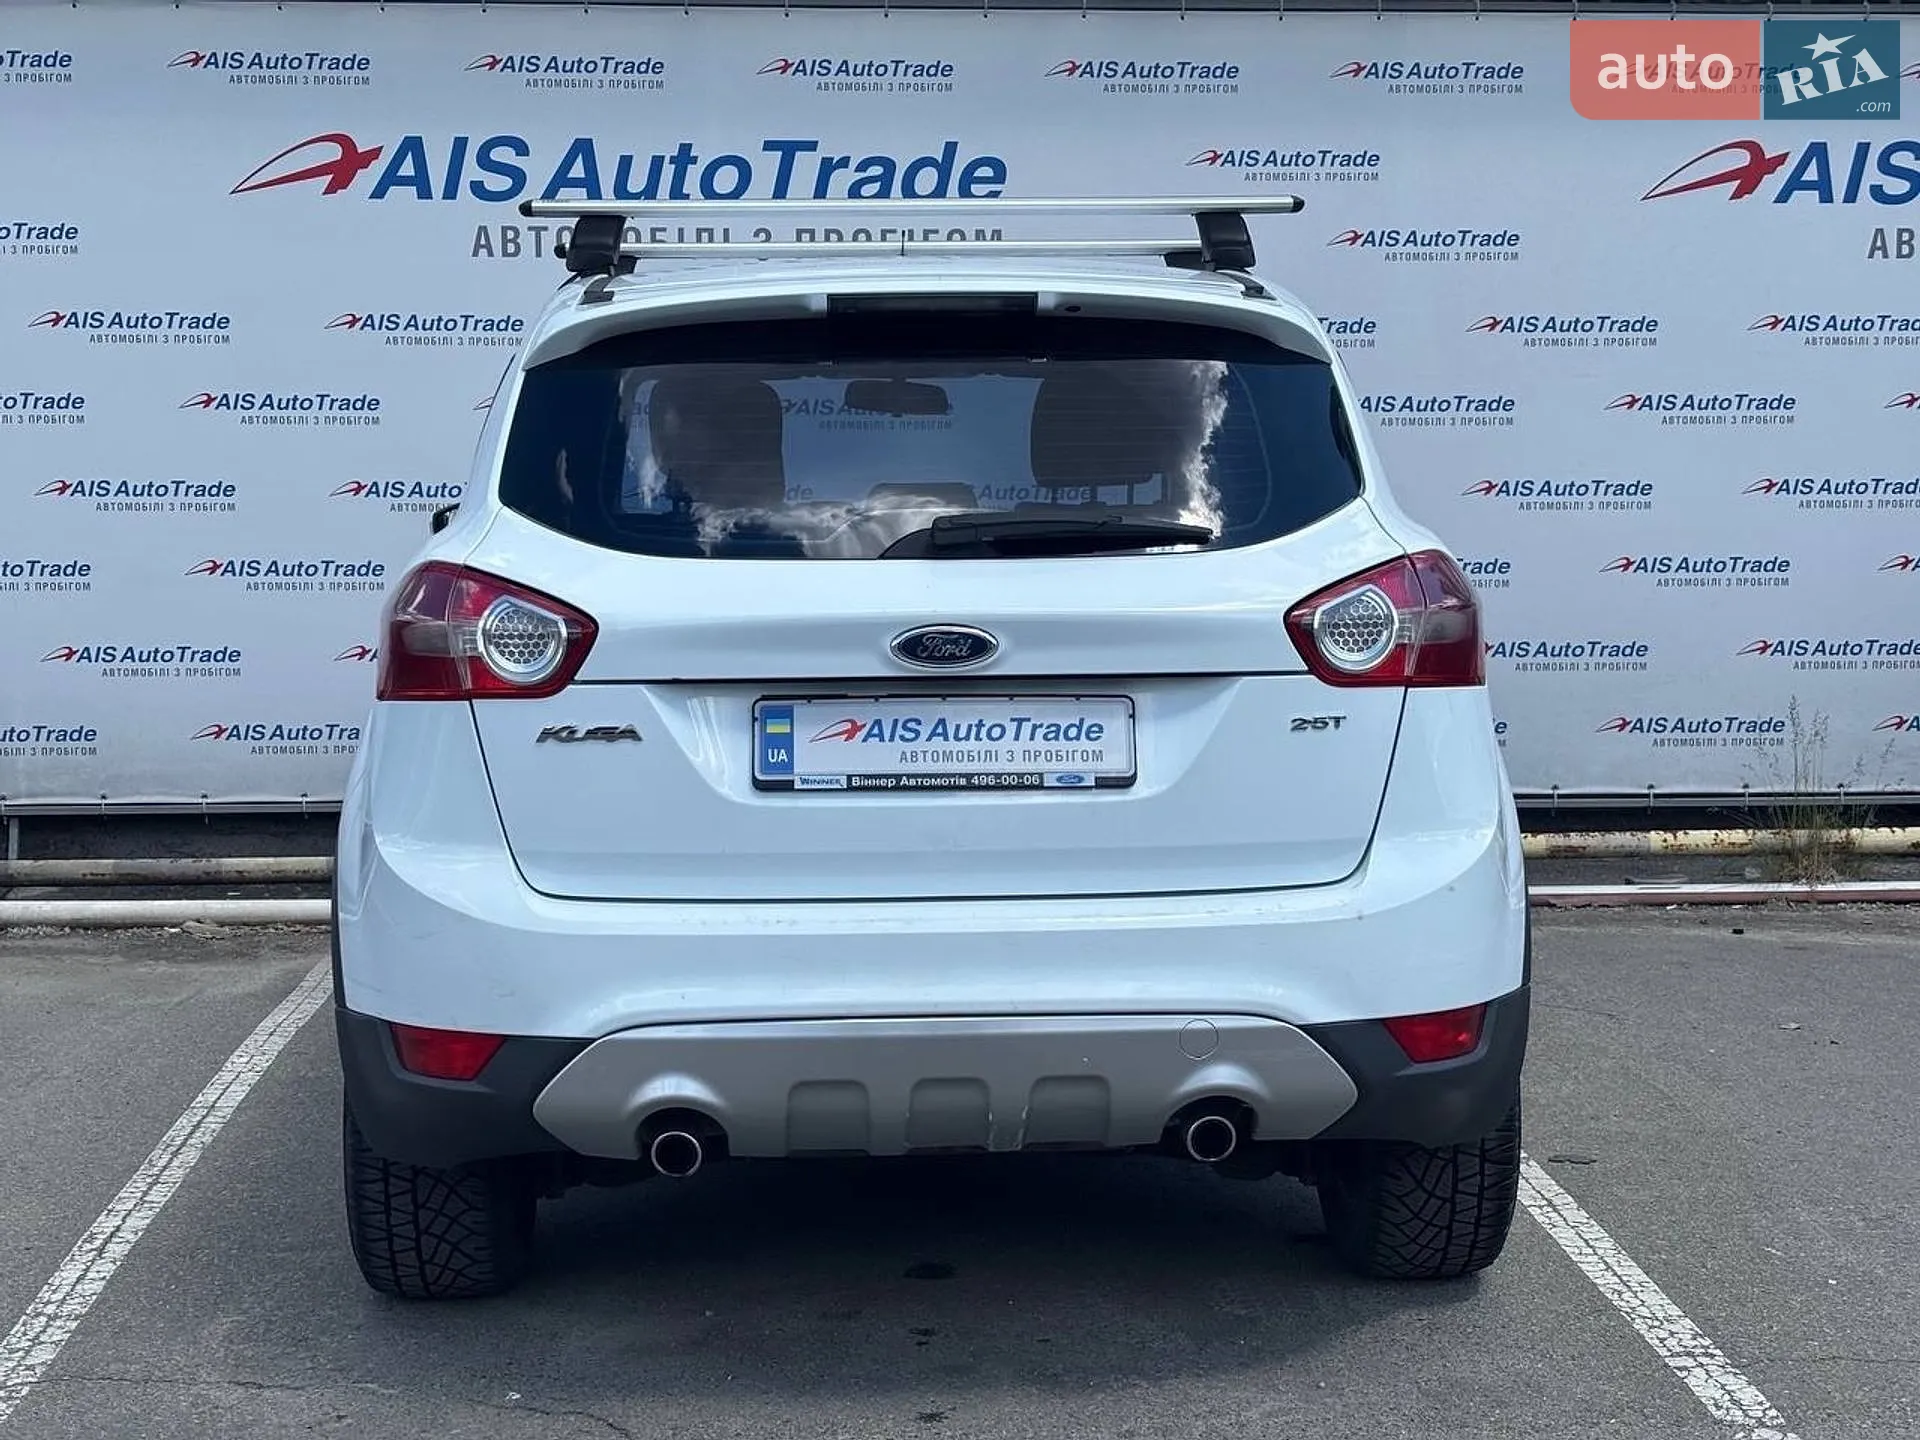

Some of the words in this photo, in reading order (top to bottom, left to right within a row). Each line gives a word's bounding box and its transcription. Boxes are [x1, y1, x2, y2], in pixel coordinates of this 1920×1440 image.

[203, 52, 244, 69] AIS
[248, 53, 370, 70] AutoTrade
[500, 56, 541, 73] AIS
[544, 56, 664, 74] AutoTrade
[792, 59, 832, 76] AIS
[835, 60, 954, 77] AutoTrade
[1079, 61, 1119, 78] AIS
[1121, 61, 1240, 79] AutoTrade
[1364, 62, 1404, 79] AIS
[1406, 62, 1524, 79] AutoTrade
[1220, 150, 1260, 167] AIS
[1262, 150, 1380, 167] AutoTrade
[370, 136, 530, 201] AIS
[540, 137, 1007, 200] AutoTrade
[1360, 231, 1401, 247] AIS
[1403, 230, 1520, 247] AutoTrade
[63, 312, 105, 328] AIS
[108, 312, 230, 329] AutoTrade
[360, 314, 400, 331] AIS
[403, 314, 524, 332] AutoTrade
[1499, 317, 1540, 333] AIS
[1541, 316, 1659, 333] AutoTrade
[1781, 315, 1821, 331] AIS
[0, 392, 85, 410] oTrade
[215, 394, 256, 410] AIS
[259, 394, 380, 411] AutoTrade
[1398, 395, 1515, 412] AutoTrade
[1638, 395, 1678, 411] AIS
[1680, 394, 1796, 411] AutoTrade
[70, 480, 111, 497] AIS
[114, 480, 236, 498] AutoTrade
[365, 482, 405, 498] AIS
[1495, 481, 1535, 496] AIS
[1537, 480, 1653, 496] AutoTrade
[1775, 479, 1815, 495] AIS
[1816, 478, 1920, 495] AutoTrad
[1, 560, 91, 577] toTrade
[220, 560, 261, 576] AIS
[264, 560, 385, 577] AutoTrade
[1633, 557, 1673, 573] AIS
[1674, 556, 1791, 573] AutoTrade
[76, 647, 117, 663] AIS
[120, 646, 241, 663] AutoTrade
[1491, 642, 1531, 658] AIS
[1533, 641, 1648, 658] AutoTrade
[1770, 640, 1810, 656] AIS
[225, 725, 266, 741] AIS
[269, 724, 360, 741] AutoTra
[862, 718, 923, 743] AIS
[925, 717, 1104, 743] AutoTrade
[1629, 718, 1668, 733] AIS
[1670, 717, 1786, 733] AutoTrade
[768, 749, 788, 763] UA
[900, 749, 999, 763] АВТОМОБІЛІ
[1022, 749, 1104, 763] ПРОБІГОМ
[852, 777, 896, 789] Віннер
[971, 775, 1039, 785] 496-00-06
